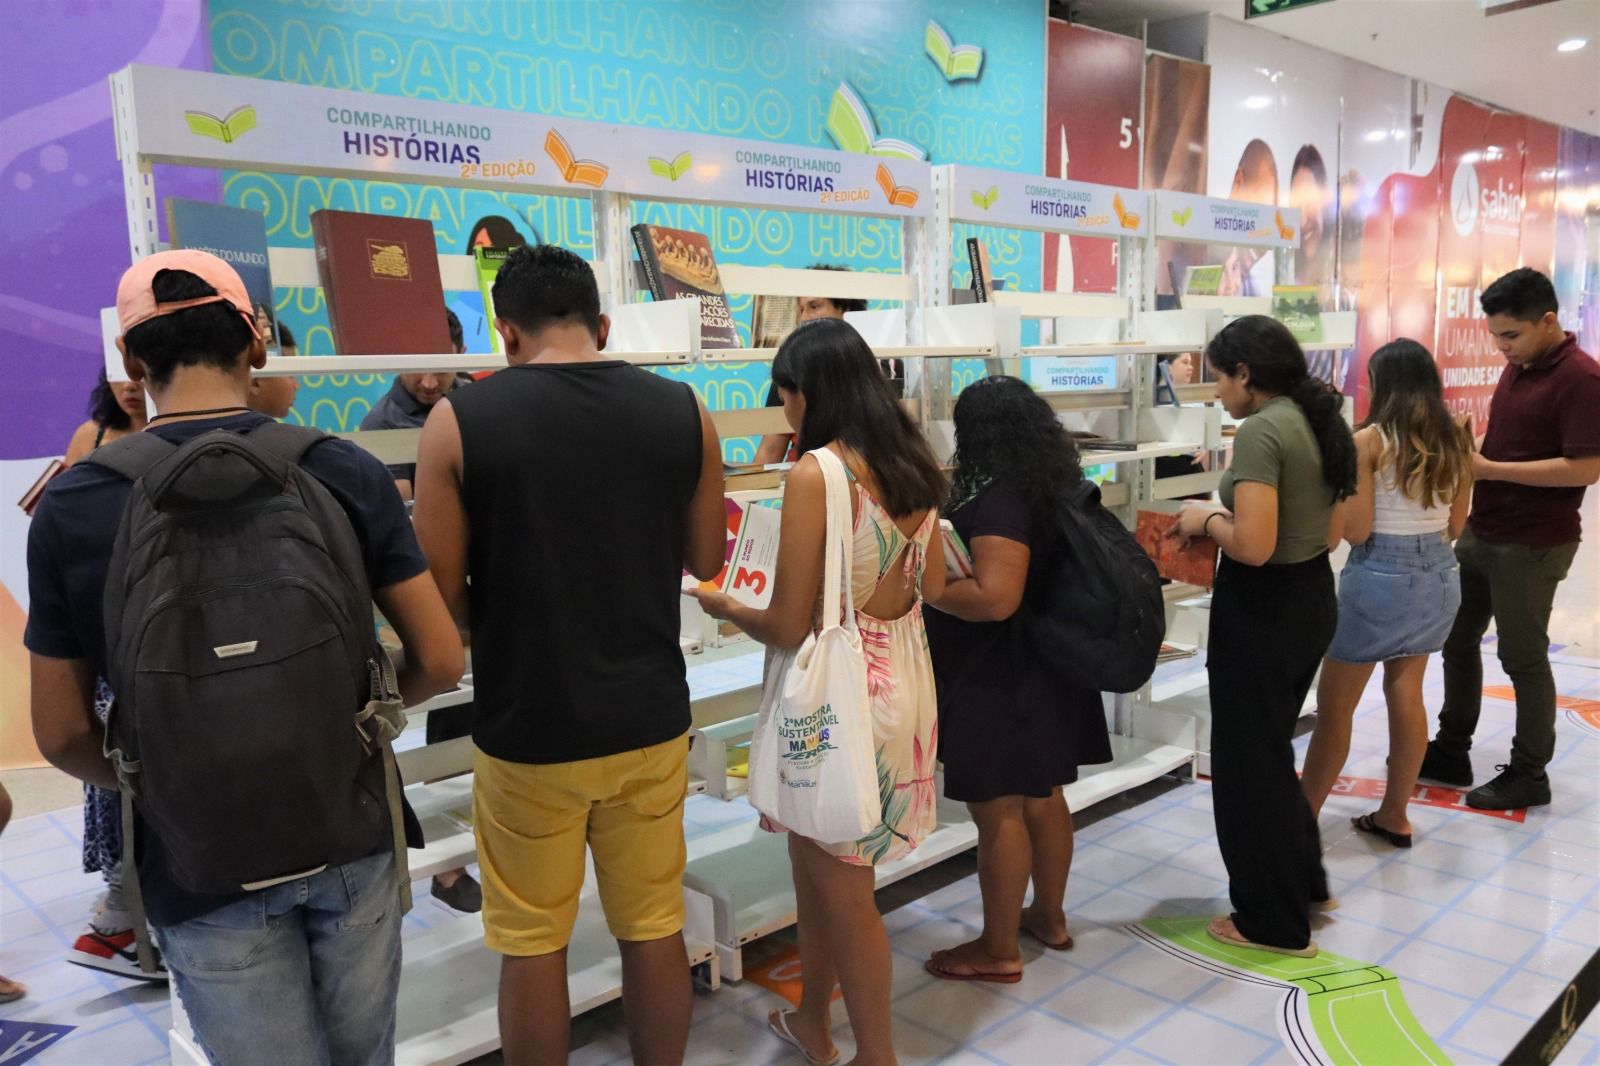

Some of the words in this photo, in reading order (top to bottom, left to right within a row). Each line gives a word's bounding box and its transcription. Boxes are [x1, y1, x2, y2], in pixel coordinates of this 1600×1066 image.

[327, 107, 491, 141] COMPARTILHANDO
[1119, 117, 1133, 149] 5
[343, 130, 481, 165] HISTÓRIAS
[481, 158, 536, 180] EDIÇÃO
[736, 150, 841, 174] COMPARTILHANDO
[745, 168, 834, 193] HISTÓRIAS
[834, 187, 871, 202] EDIÇÃO
[1025, 184, 1092, 203] COMPARTILHANDO
[1480, 176, 1521, 224] sabin
[1030, 198, 1087, 219] HISTÓRIAS
[1214, 215, 1256, 232] HISTÓRIAS
[234, 251, 266, 265] MUNDO
[1447, 286, 1470, 319] EM
[1051, 373, 1104, 386] HISTÓRIAS
[1443, 367, 1486, 389] UNIDADE
